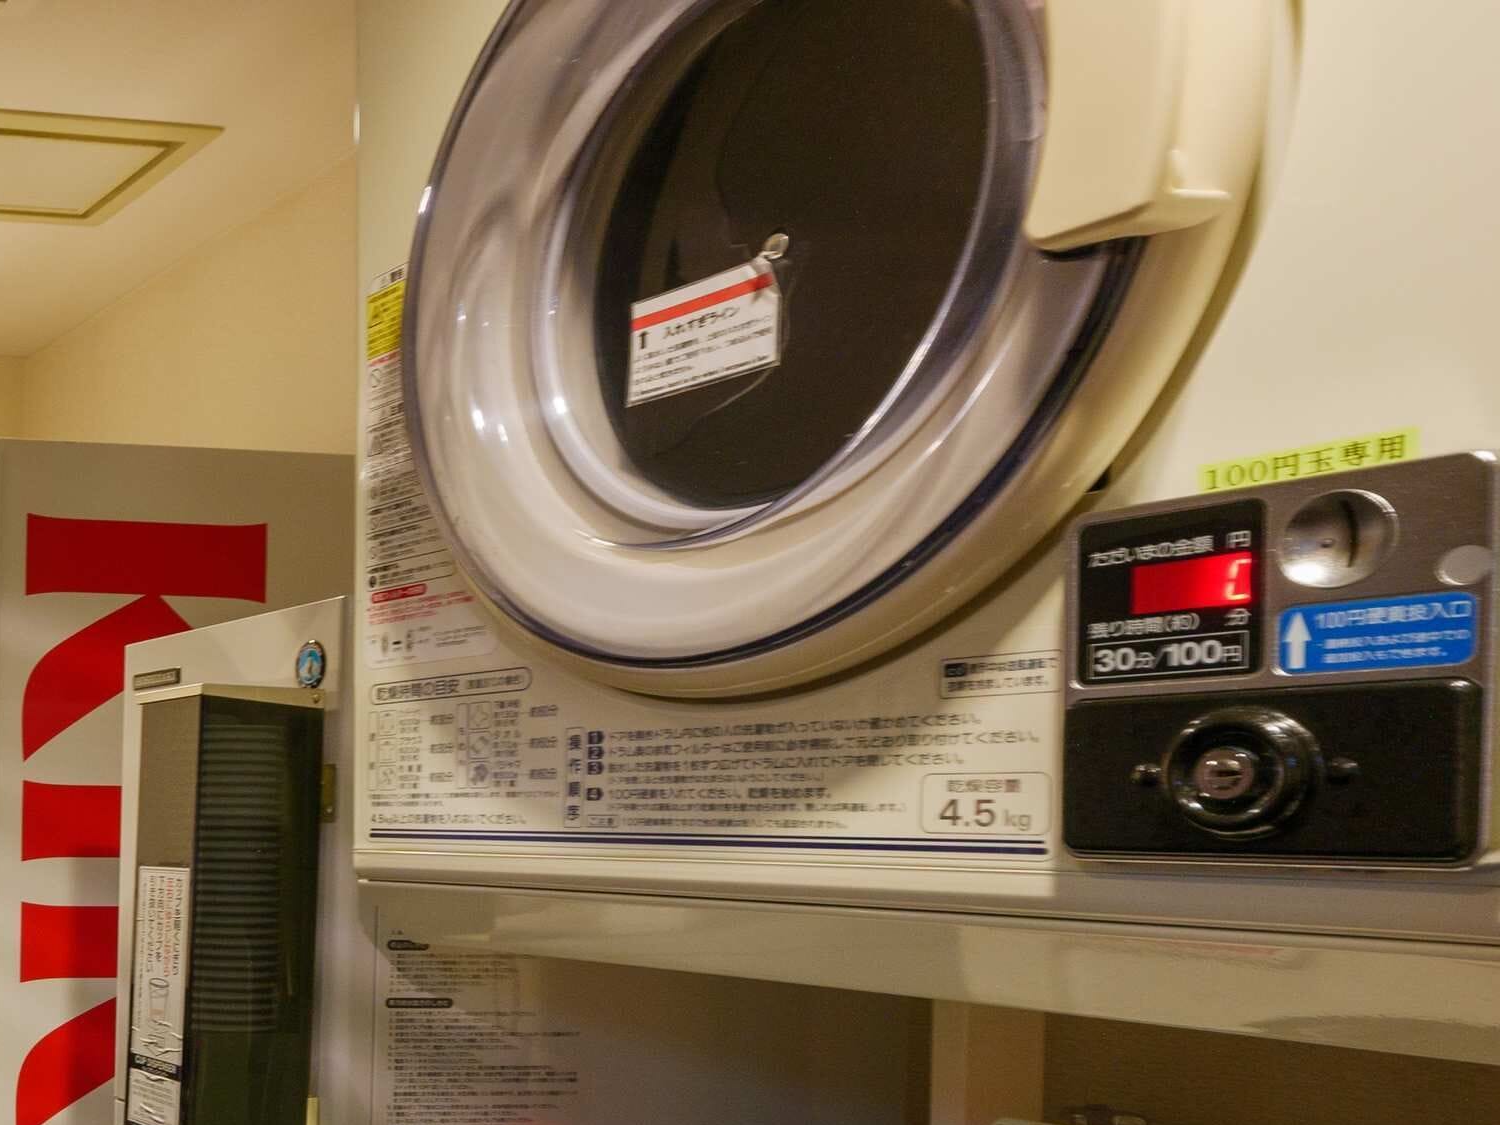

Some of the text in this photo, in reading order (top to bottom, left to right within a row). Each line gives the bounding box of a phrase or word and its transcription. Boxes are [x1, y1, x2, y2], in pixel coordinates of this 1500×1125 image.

[1205, 434, 1406, 490] 100円玉専用
[939, 798, 1033, 830] 4.5 kg
